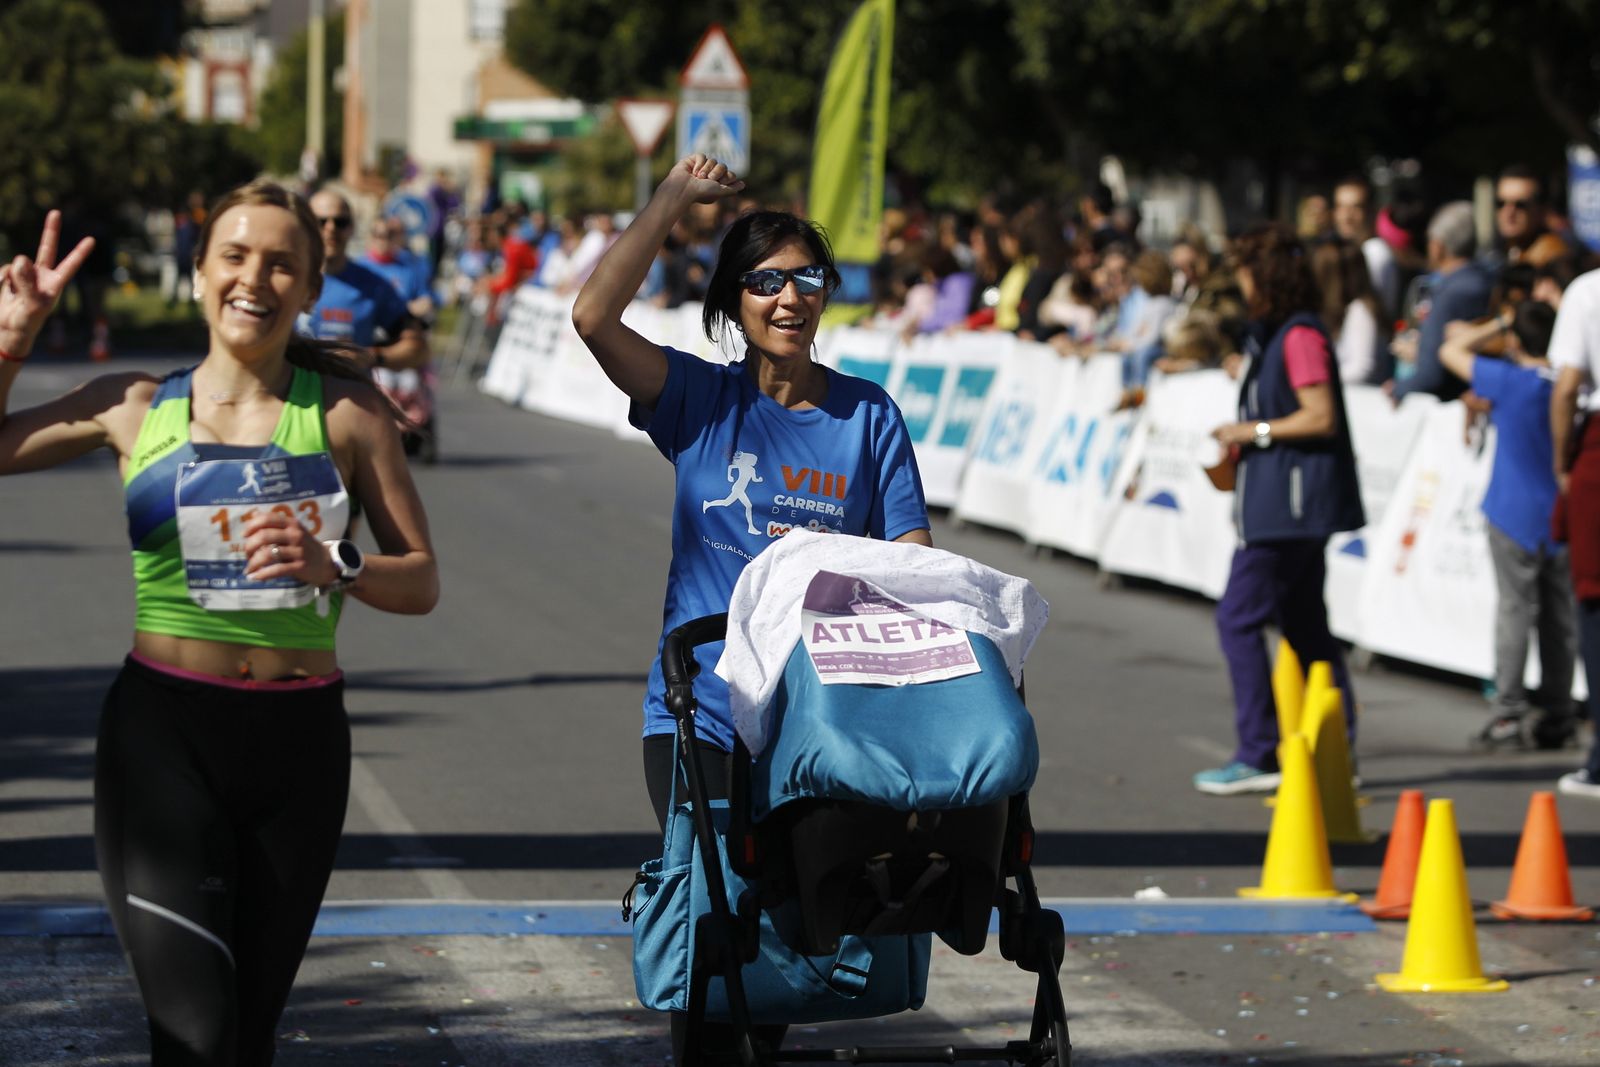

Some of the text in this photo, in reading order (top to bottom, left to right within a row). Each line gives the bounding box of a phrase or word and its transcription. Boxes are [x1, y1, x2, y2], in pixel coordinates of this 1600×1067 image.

[781, 464, 847, 500] VIII
[772, 506, 843, 528] DE LA
[774, 494, 845, 518] CARRERA
[711, 541, 754, 562] IGUALDAD
[811, 618, 956, 644] ATLETA
